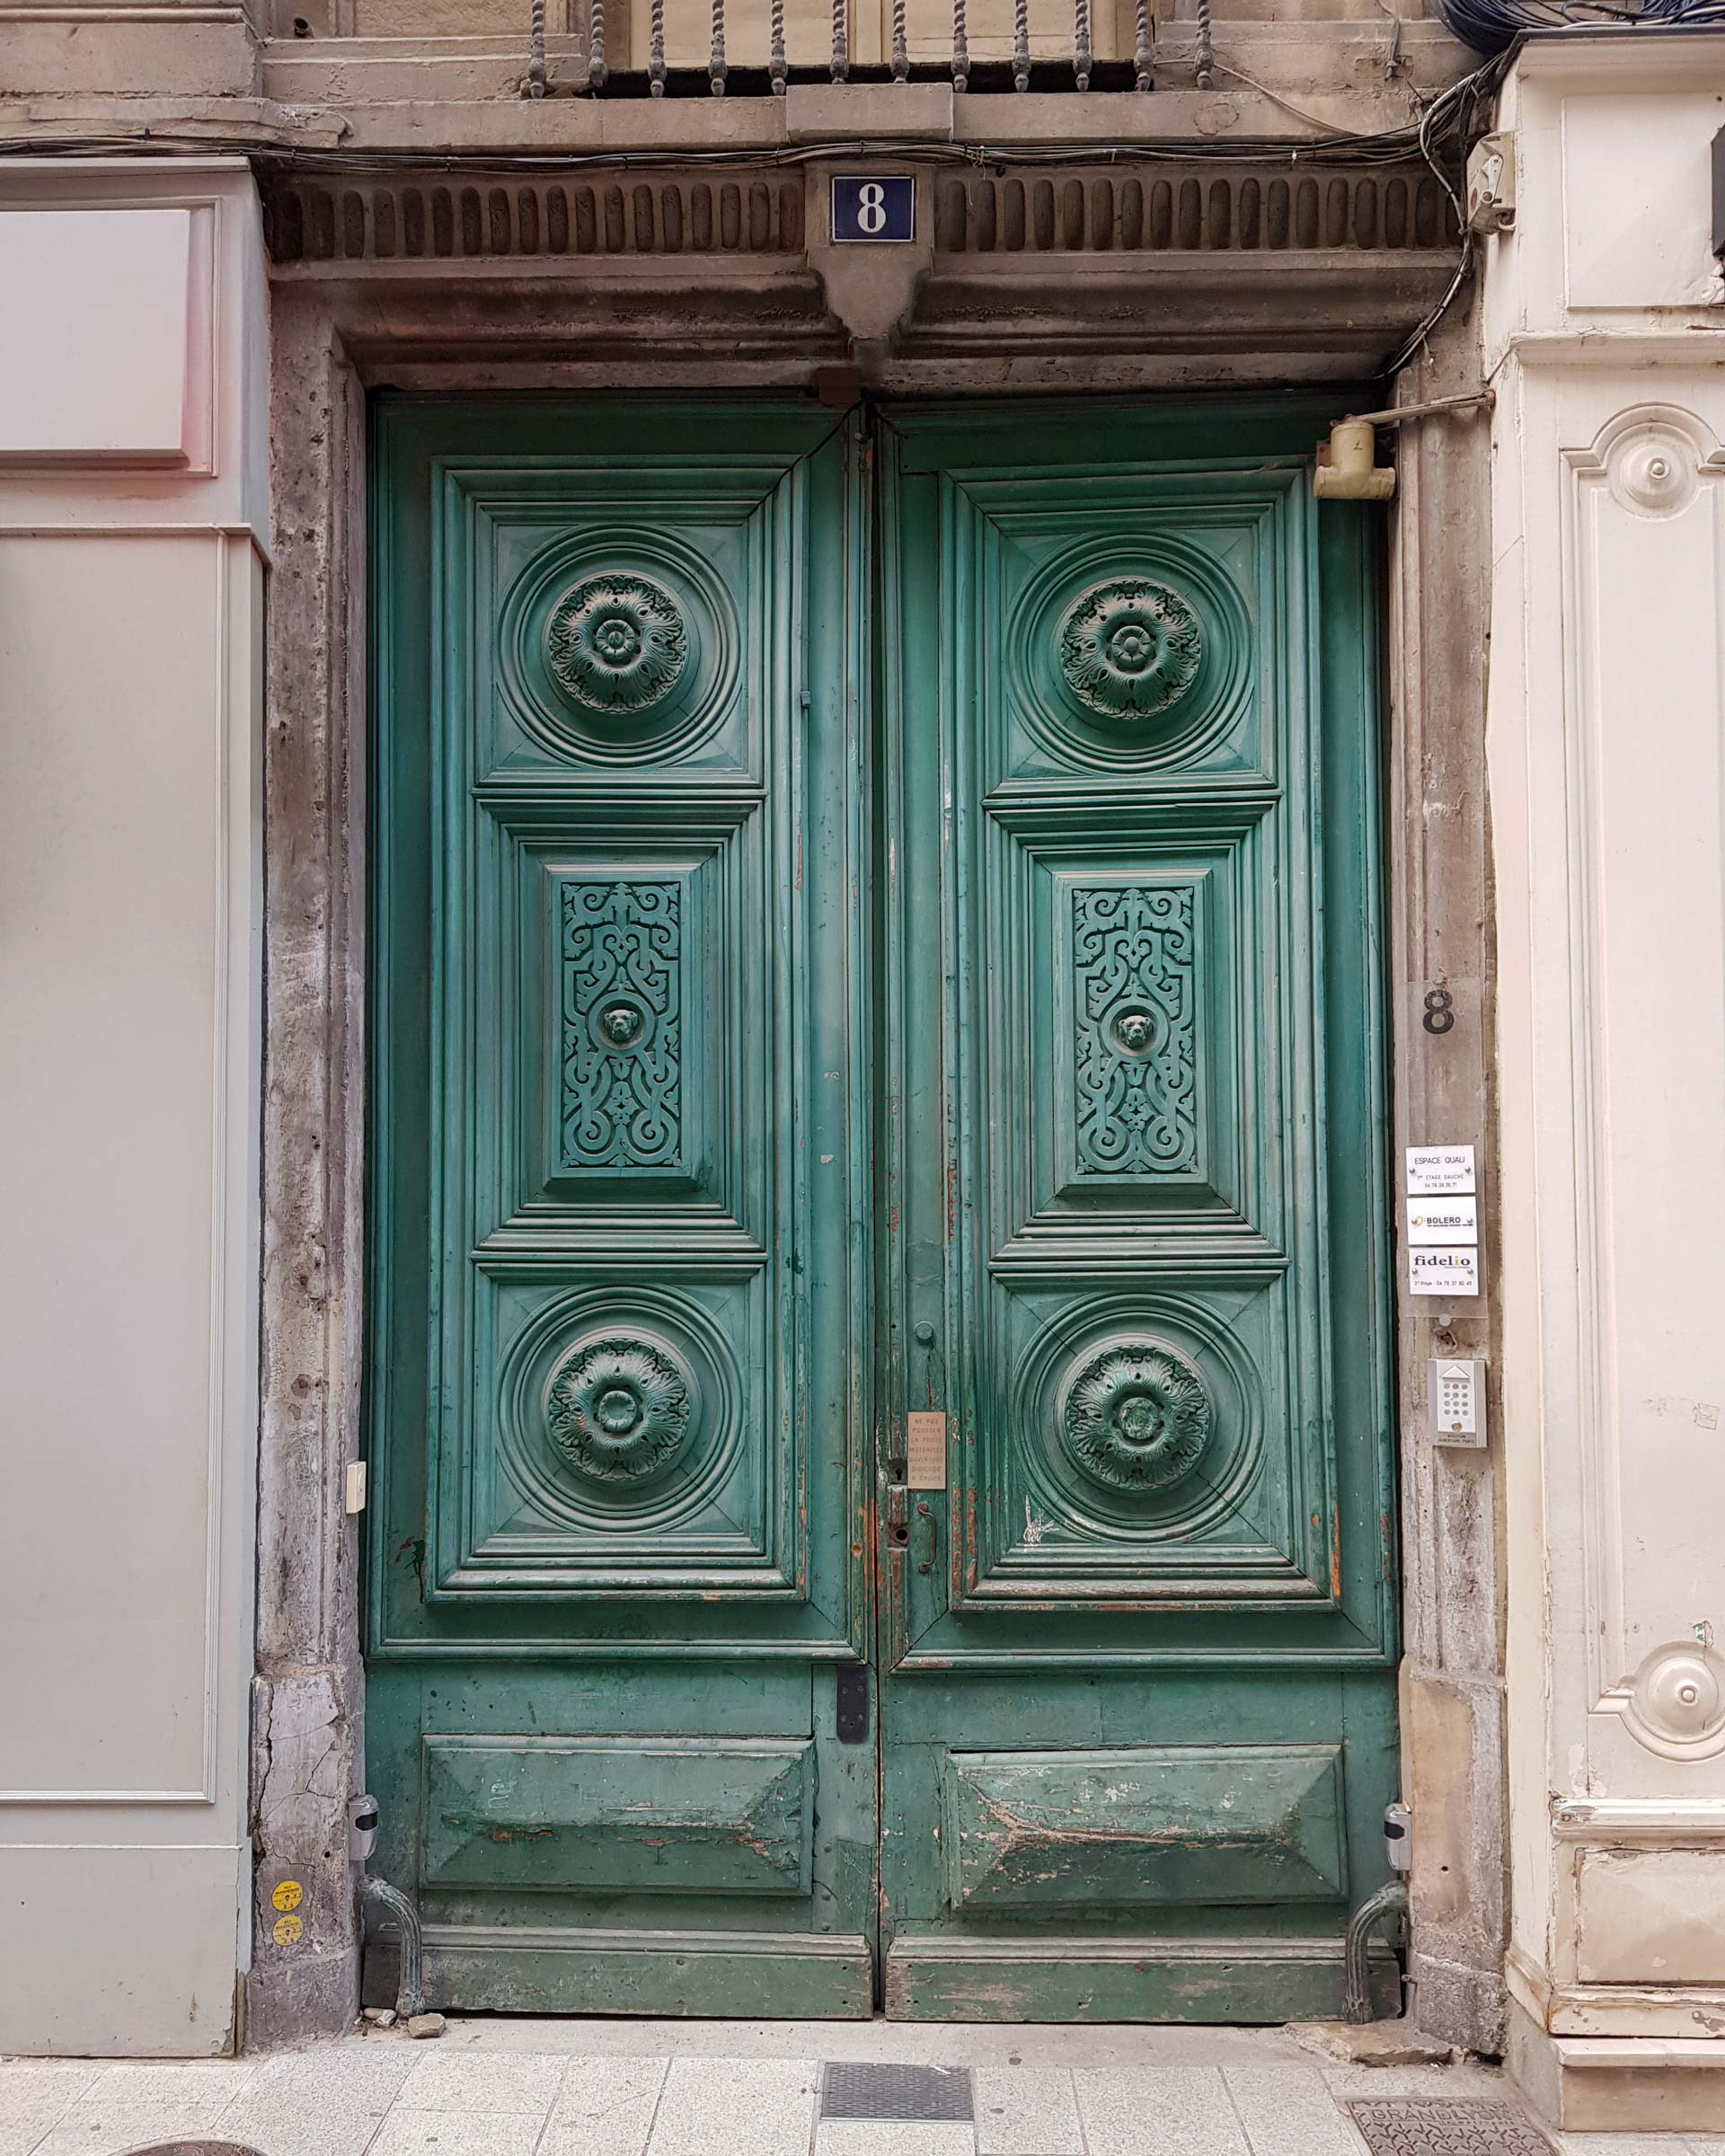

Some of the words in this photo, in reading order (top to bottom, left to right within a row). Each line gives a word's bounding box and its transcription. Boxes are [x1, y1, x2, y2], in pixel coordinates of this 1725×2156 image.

[857, 182, 887, 234] 8
[1422, 989, 1455, 1035] 8
[1427, 1216, 1461, 1224] BOLERO
[1414, 1255, 1471, 1266] fidelio
